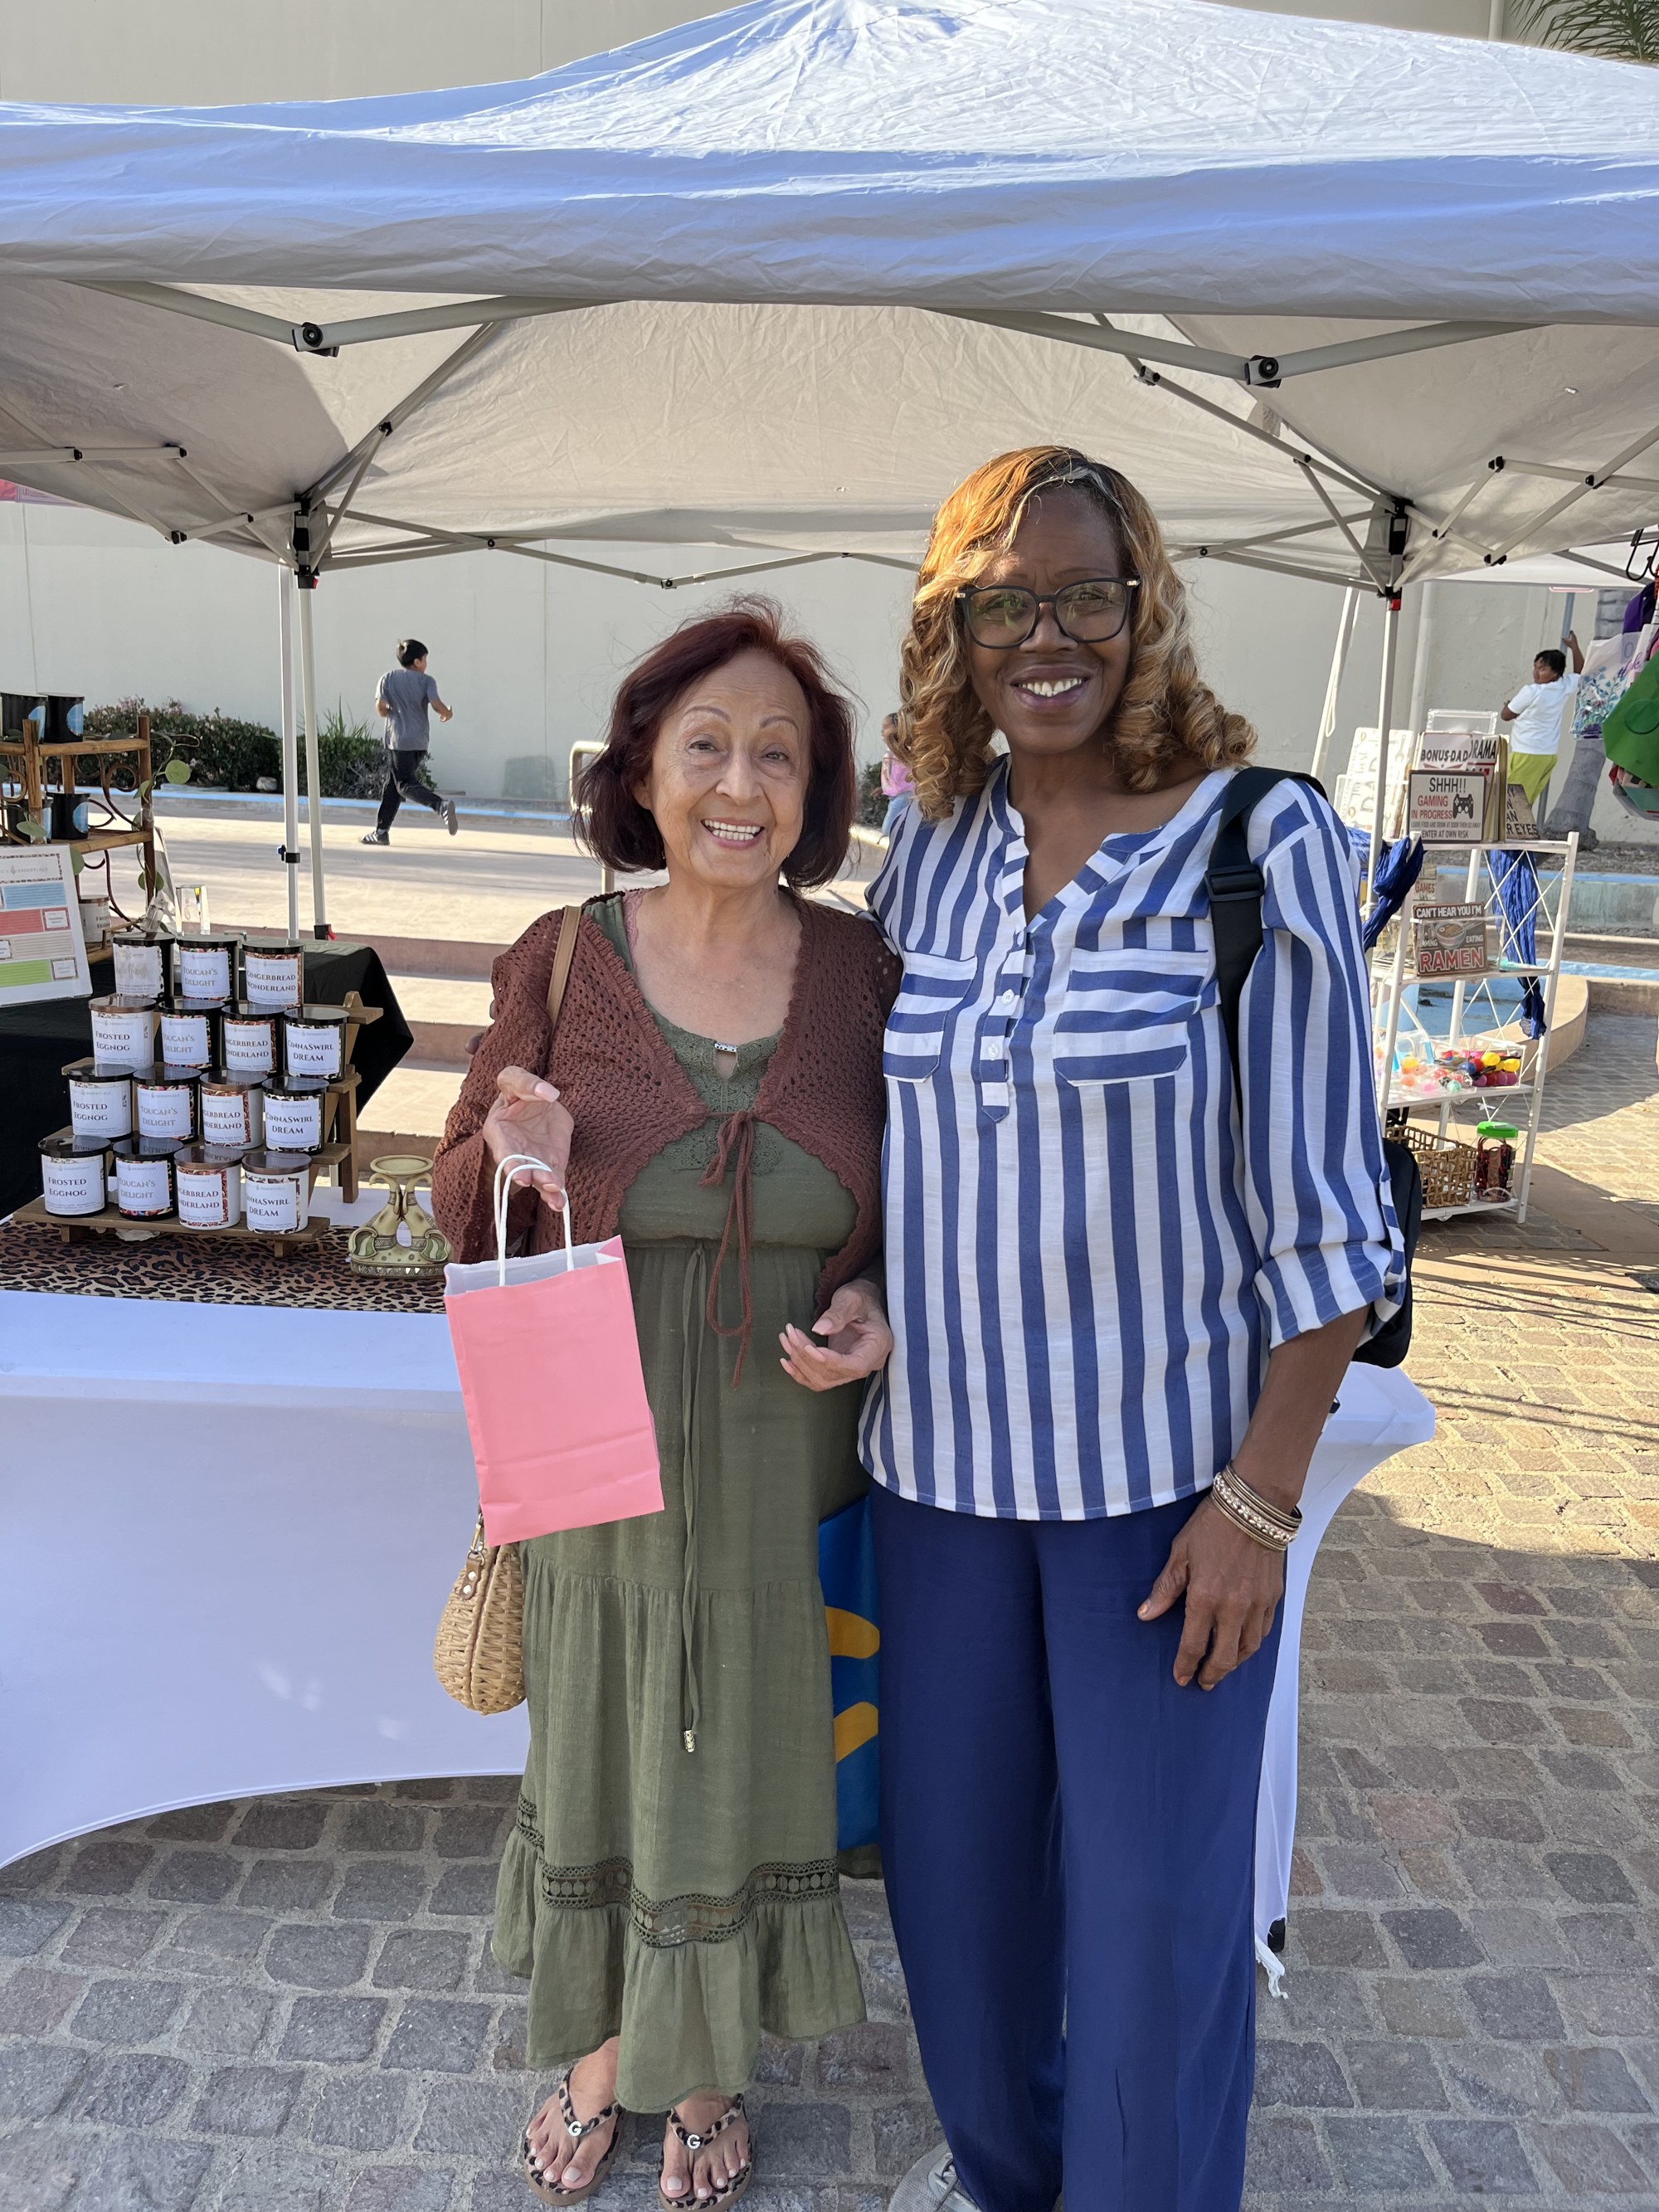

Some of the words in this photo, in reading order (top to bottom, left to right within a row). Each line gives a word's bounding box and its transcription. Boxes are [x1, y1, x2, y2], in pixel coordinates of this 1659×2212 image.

[1428, 777, 1467, 792] SHHH!!
[1418, 795, 1448, 807] GAMING
[1411, 809, 1418, 819] IN
[1419, 809, 1453, 820] PROGRESS
[1422, 830, 1438, 839] ENTER
[1438, 830, 1445, 839] AT
[1445, 830, 1457, 839] OWN
[1457, 831, 1469, 839] RISK
[1514, 823, 1539, 836] EYES
[1416, 907, 1438, 918] CAN'T
[1438, 906, 1457, 918] HEAR
[1457, 905, 1472, 917] YOU
[1472, 904, 1482, 916] I'M
[1466, 934, 1484, 944] EATING
[1419, 947, 1485, 973] RAMEN
[182, 967, 218, 977] TOUCAN'S
[246, 970, 296, 981] GINGERBREAD
[185, 978, 216, 987] DELIGHT
[95, 1030, 130, 1040] FROSTED
[96, 1041, 130, 1051] EGGNOG
[293, 1052, 324, 1062] DREAM
[73, 1100, 108, 1110] FROSTED
[140, 1105, 178, 1116] TOUCAN'S
[74, 1111, 108, 1121] EGGNOG
[143, 1118, 177, 1126] DELIGHT
[271, 1125, 304, 1134] DREAM
[48, 1177, 87, 1186] FROSTED
[49, 1188, 87, 1197] EGGNOG
[120, 1190, 154, 1199] DELIGHT
[249, 1206, 279, 1216] DREAM
[567, 2120, 582, 2137] G
[687, 2133, 701, 2149] G
